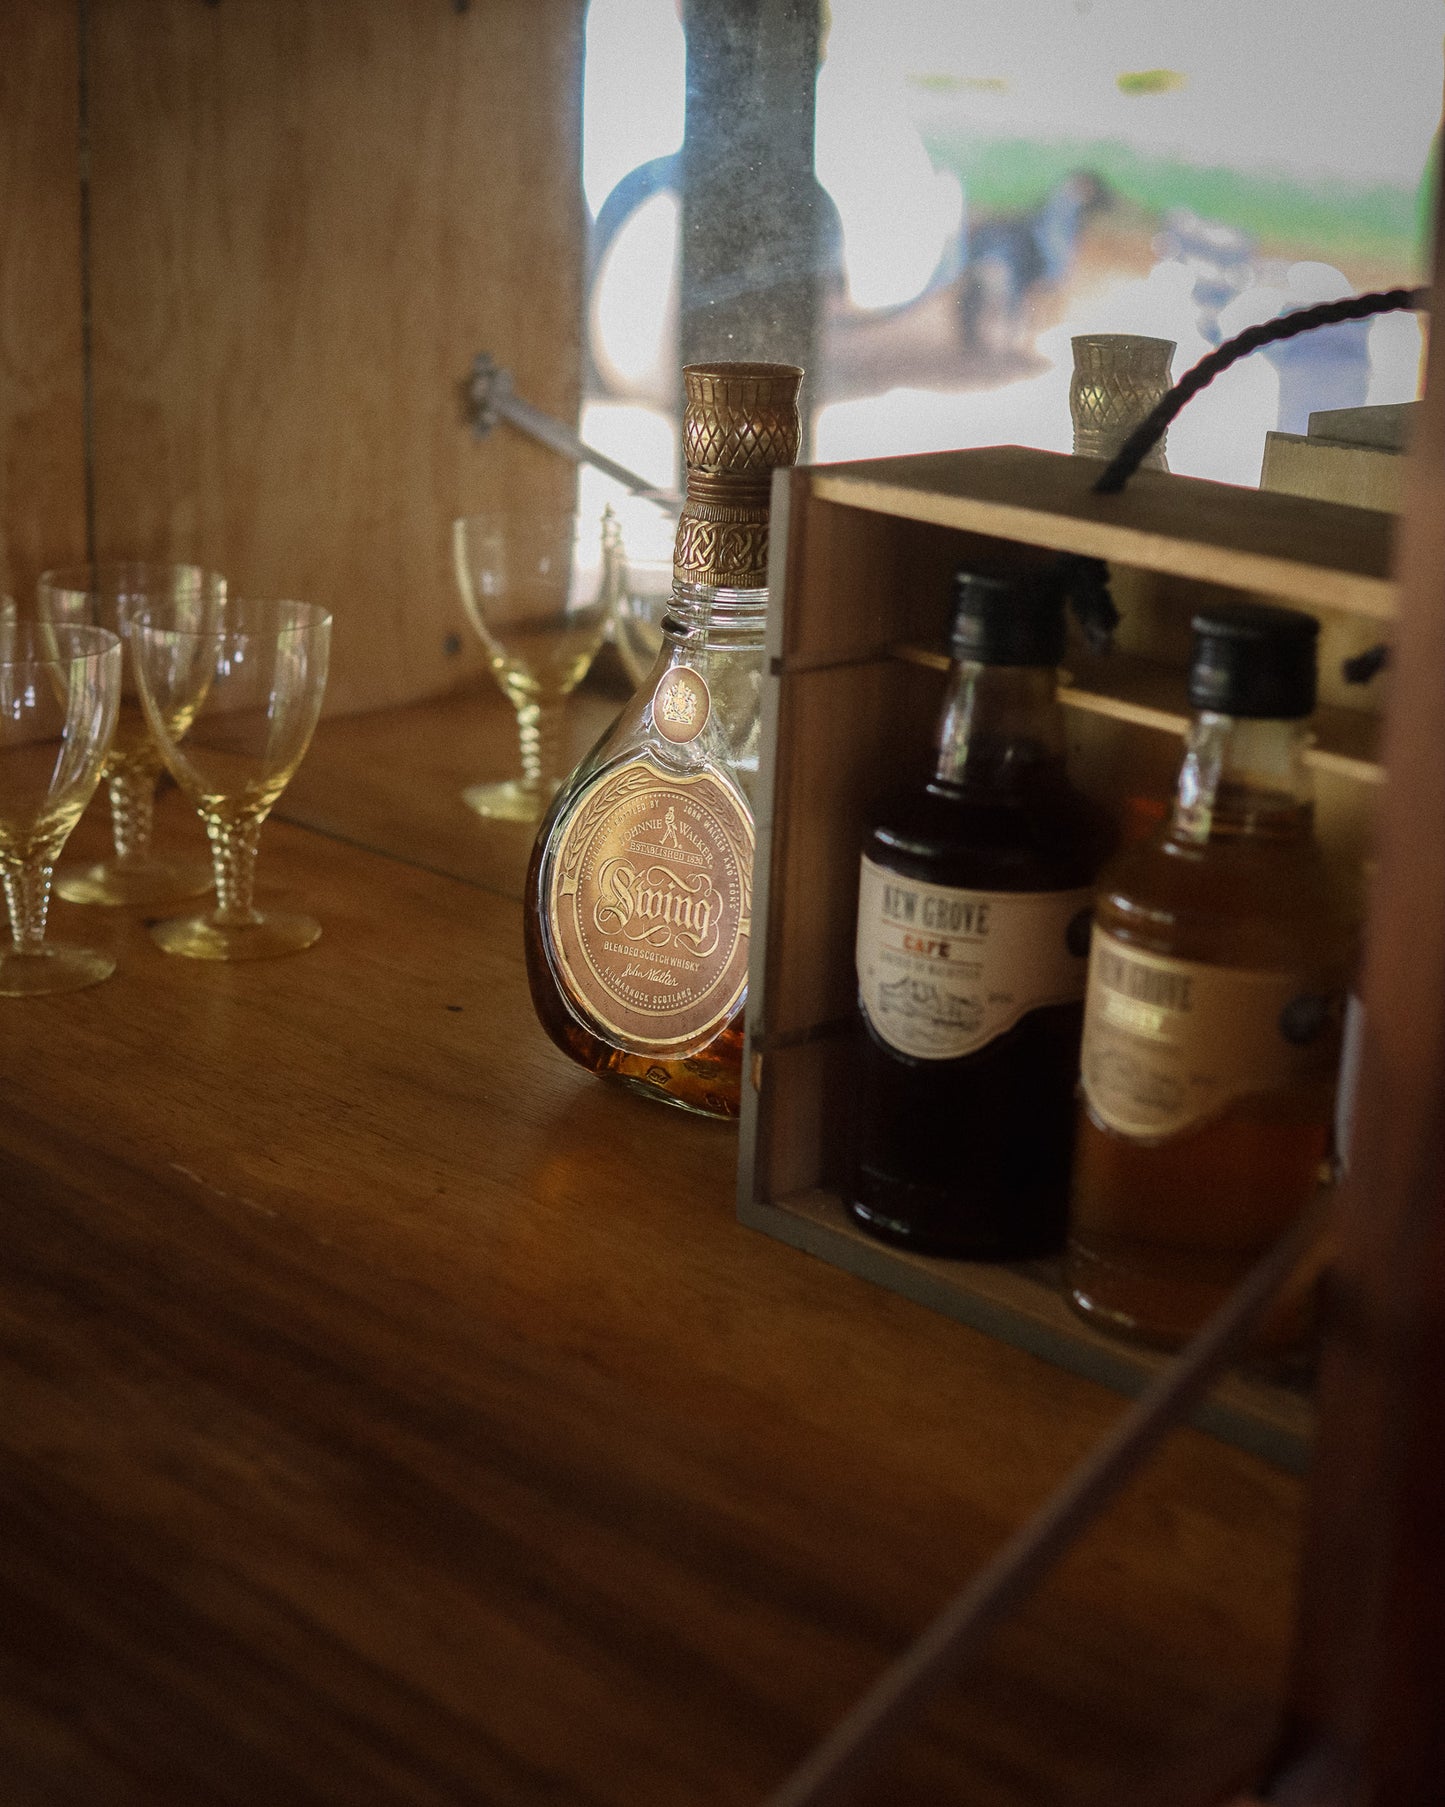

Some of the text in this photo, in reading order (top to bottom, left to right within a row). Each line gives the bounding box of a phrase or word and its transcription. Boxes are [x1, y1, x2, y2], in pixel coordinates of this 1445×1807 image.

[614, 802, 646, 827] BOTTLED
[649, 799, 659, 809] BY
[683, 805, 702, 822] JOHN
[619, 819, 713, 864] JOHNNIE WALKER
[703, 819, 726, 853] WALKER
[630, 841, 704, 866] ESTABLISHED 1820
[723, 857, 734, 876] AND
[596, 857, 721, 953] Swing
[728, 883, 737, 909] SONS
[922, 895, 990, 935] GROVE
[603, 940, 701, 972] BLENDED SCOTCH WHISKY
[604, 966, 692, 1004] KILMARNOCK SCOTLAND
[621, 963, 679, 987] John Walker
